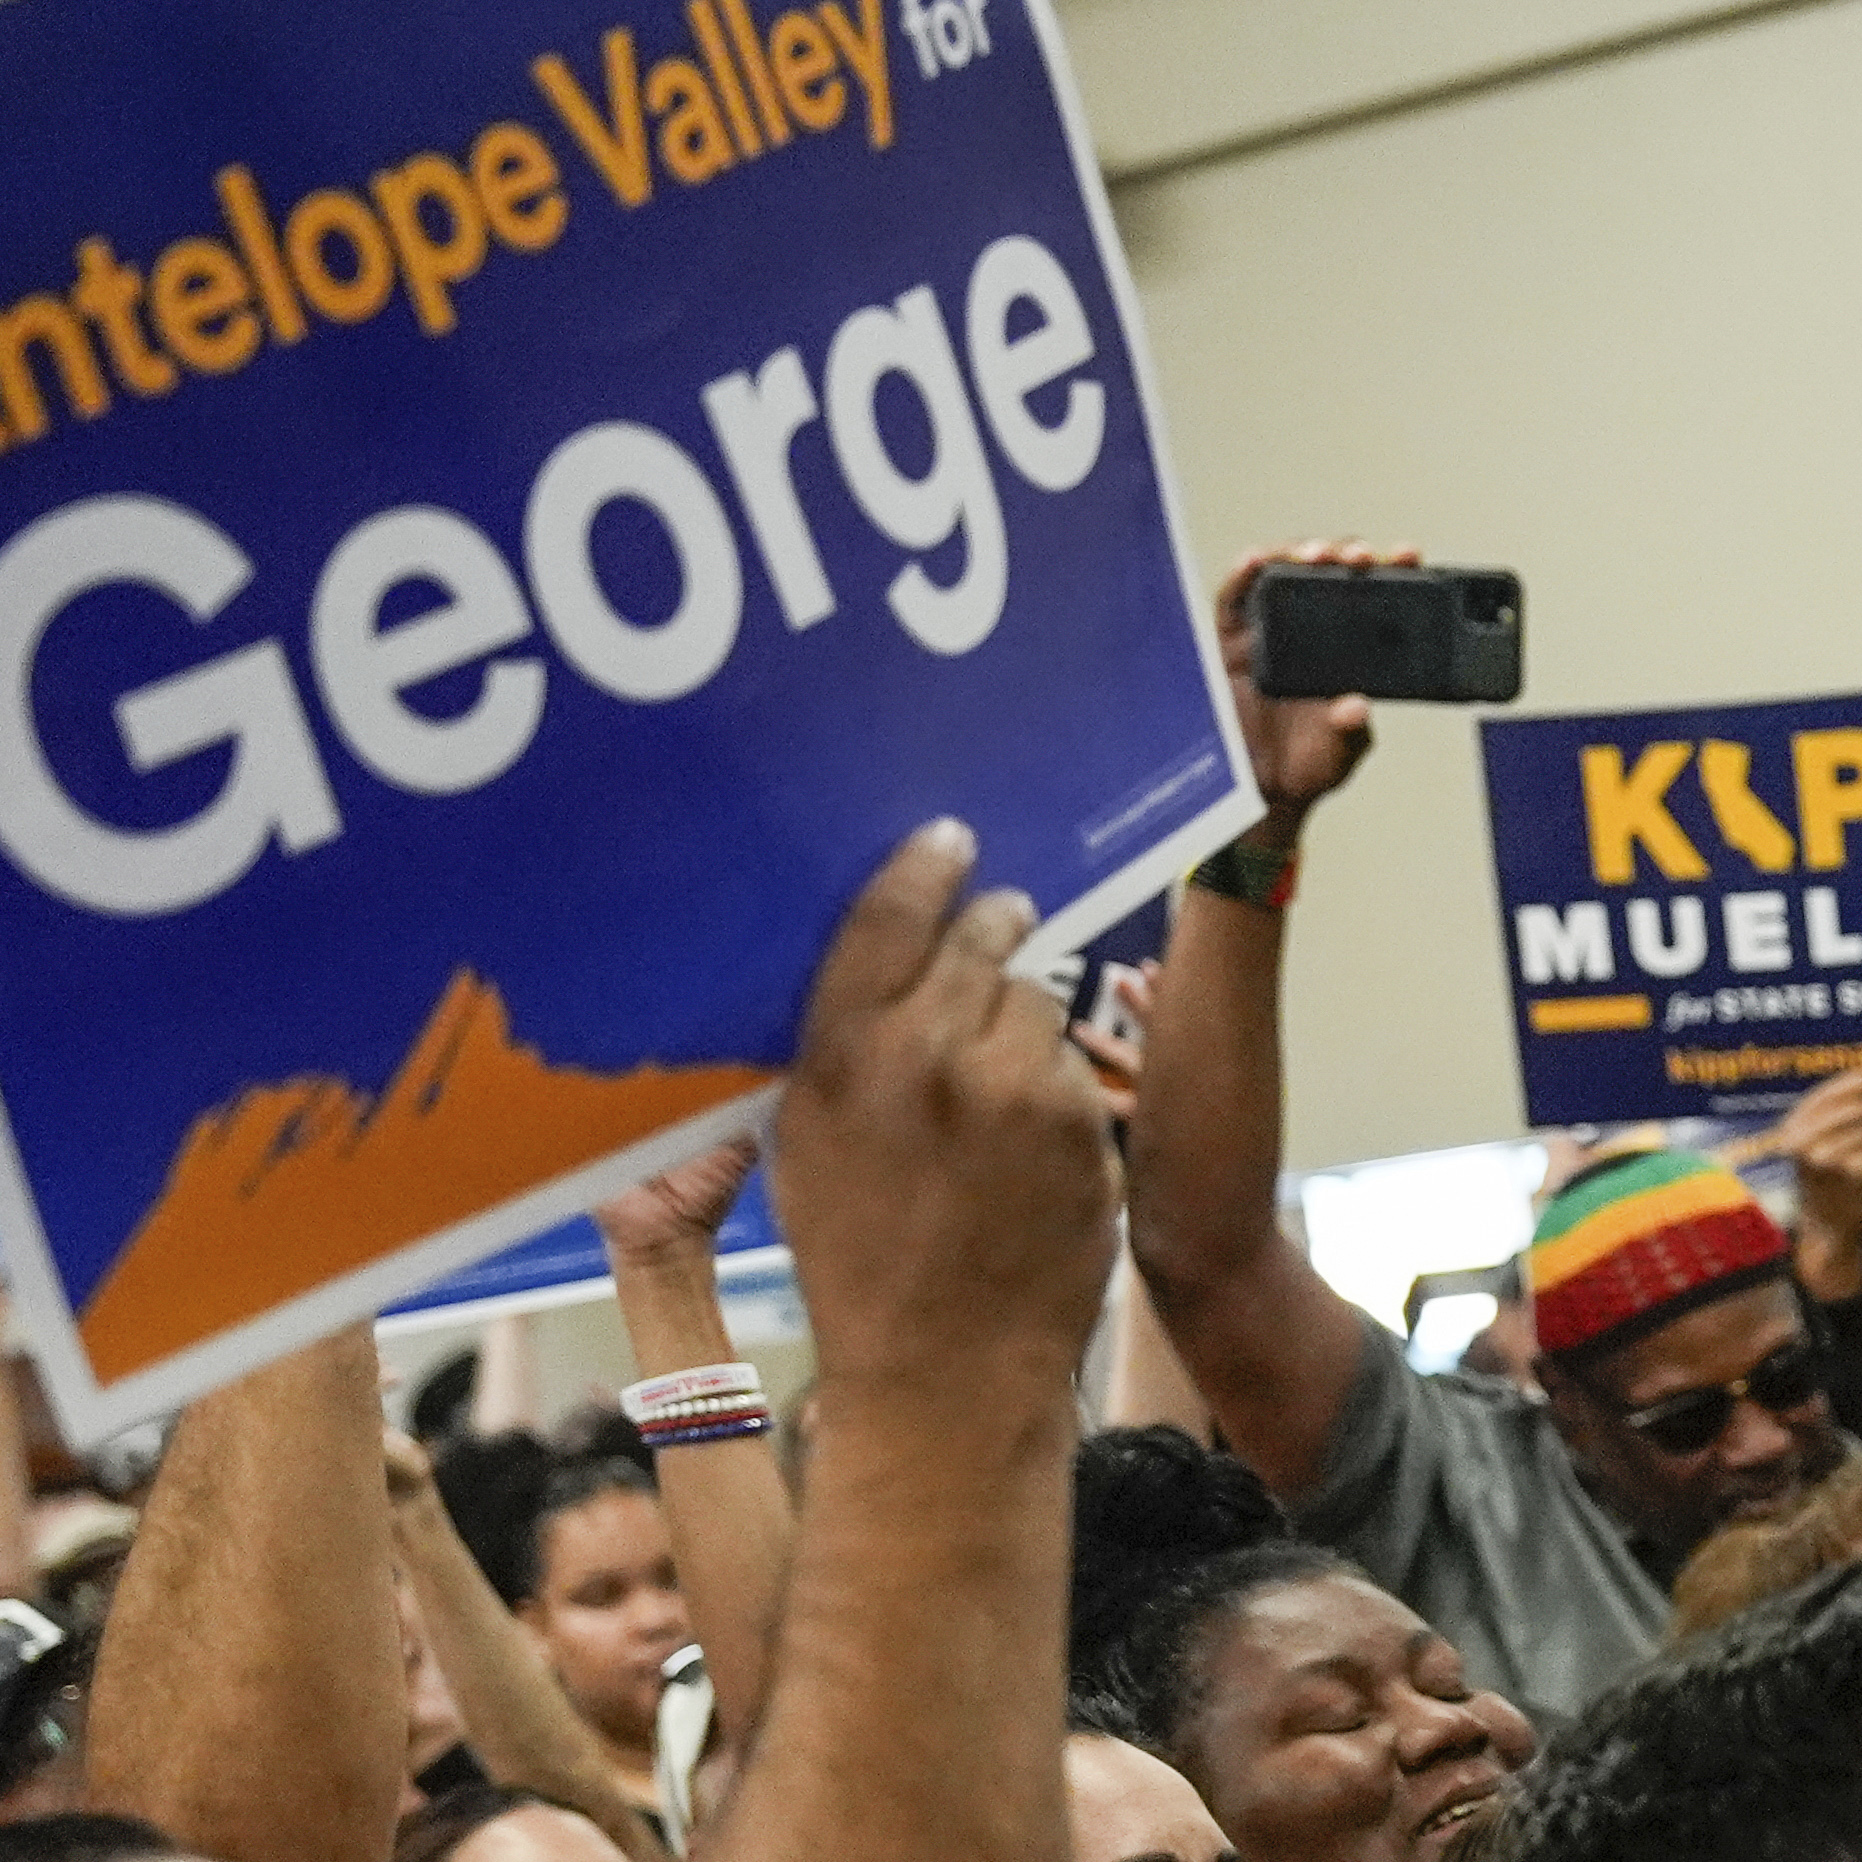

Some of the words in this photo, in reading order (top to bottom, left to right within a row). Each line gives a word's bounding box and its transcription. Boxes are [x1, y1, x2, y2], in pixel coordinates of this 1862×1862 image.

[0, 118, 572, 450] ntelope
[530, 0, 893, 207] Valley
[0, 234, 1106, 916] George
